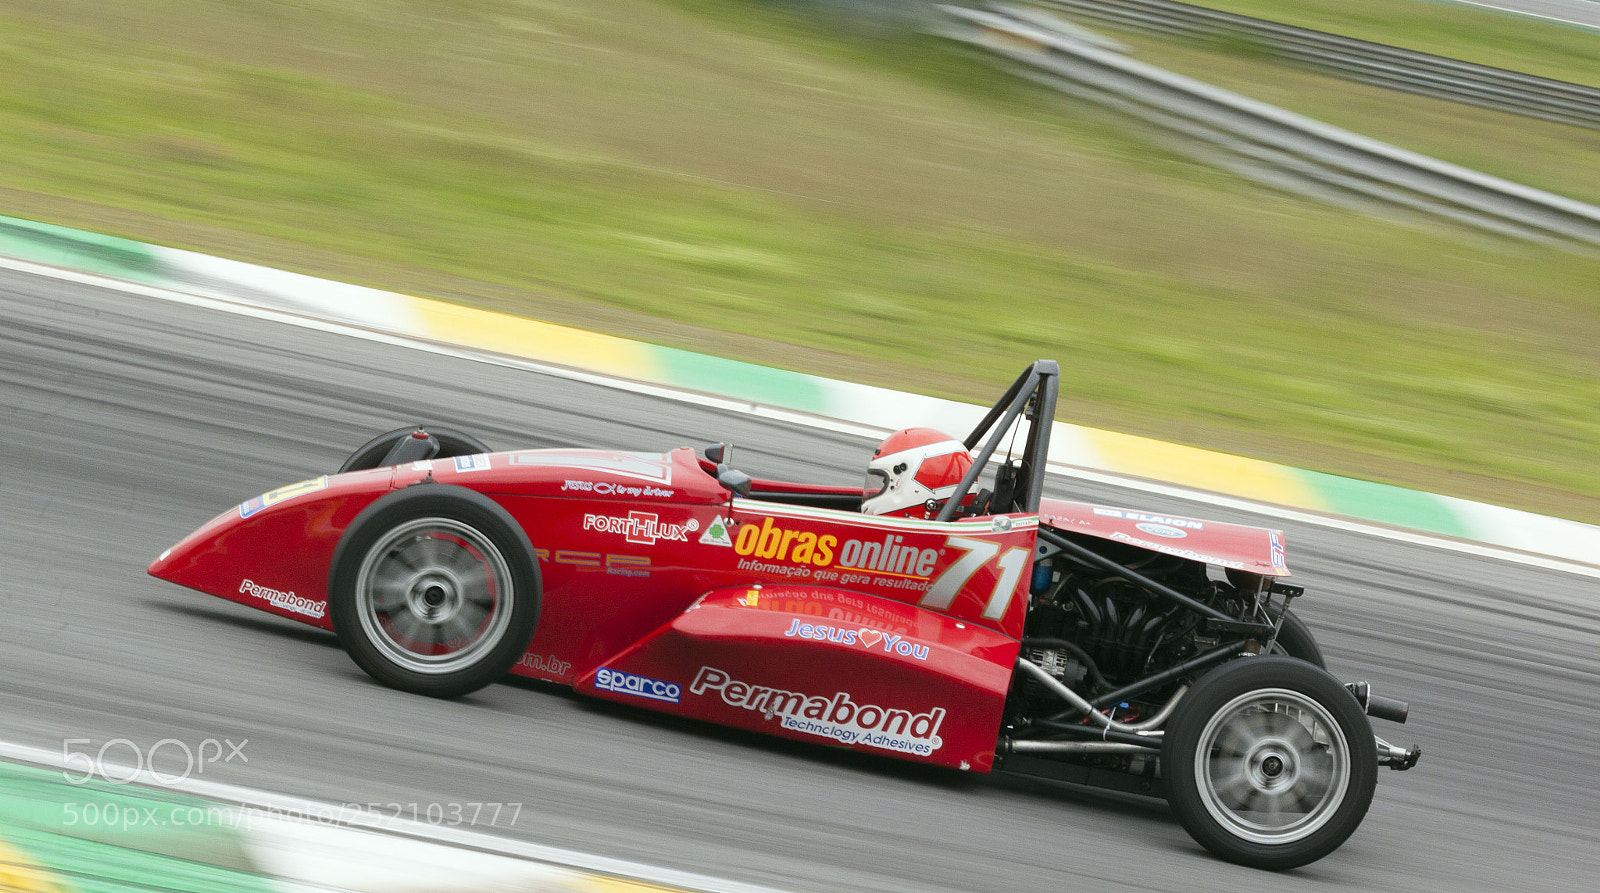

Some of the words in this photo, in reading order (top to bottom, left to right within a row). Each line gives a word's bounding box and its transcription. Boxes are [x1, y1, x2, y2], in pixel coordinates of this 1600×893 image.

[734, 517, 837, 567] obras
[840, 534, 938, 577] online
[737, 558, 810, 579] Informação
[814, 570, 839, 587] que
[841, 573, 871, 589] gera
[918, 535, 1032, 622] 71
[239, 579, 327, 613] Permabond
[785, 618, 858, 645] Jesus
[882, 632, 930, 661] You
[596, 667, 680, 699] sparco
[690, 666, 946, 740] Permabond
[862, 732, 931, 754] Adhesives
